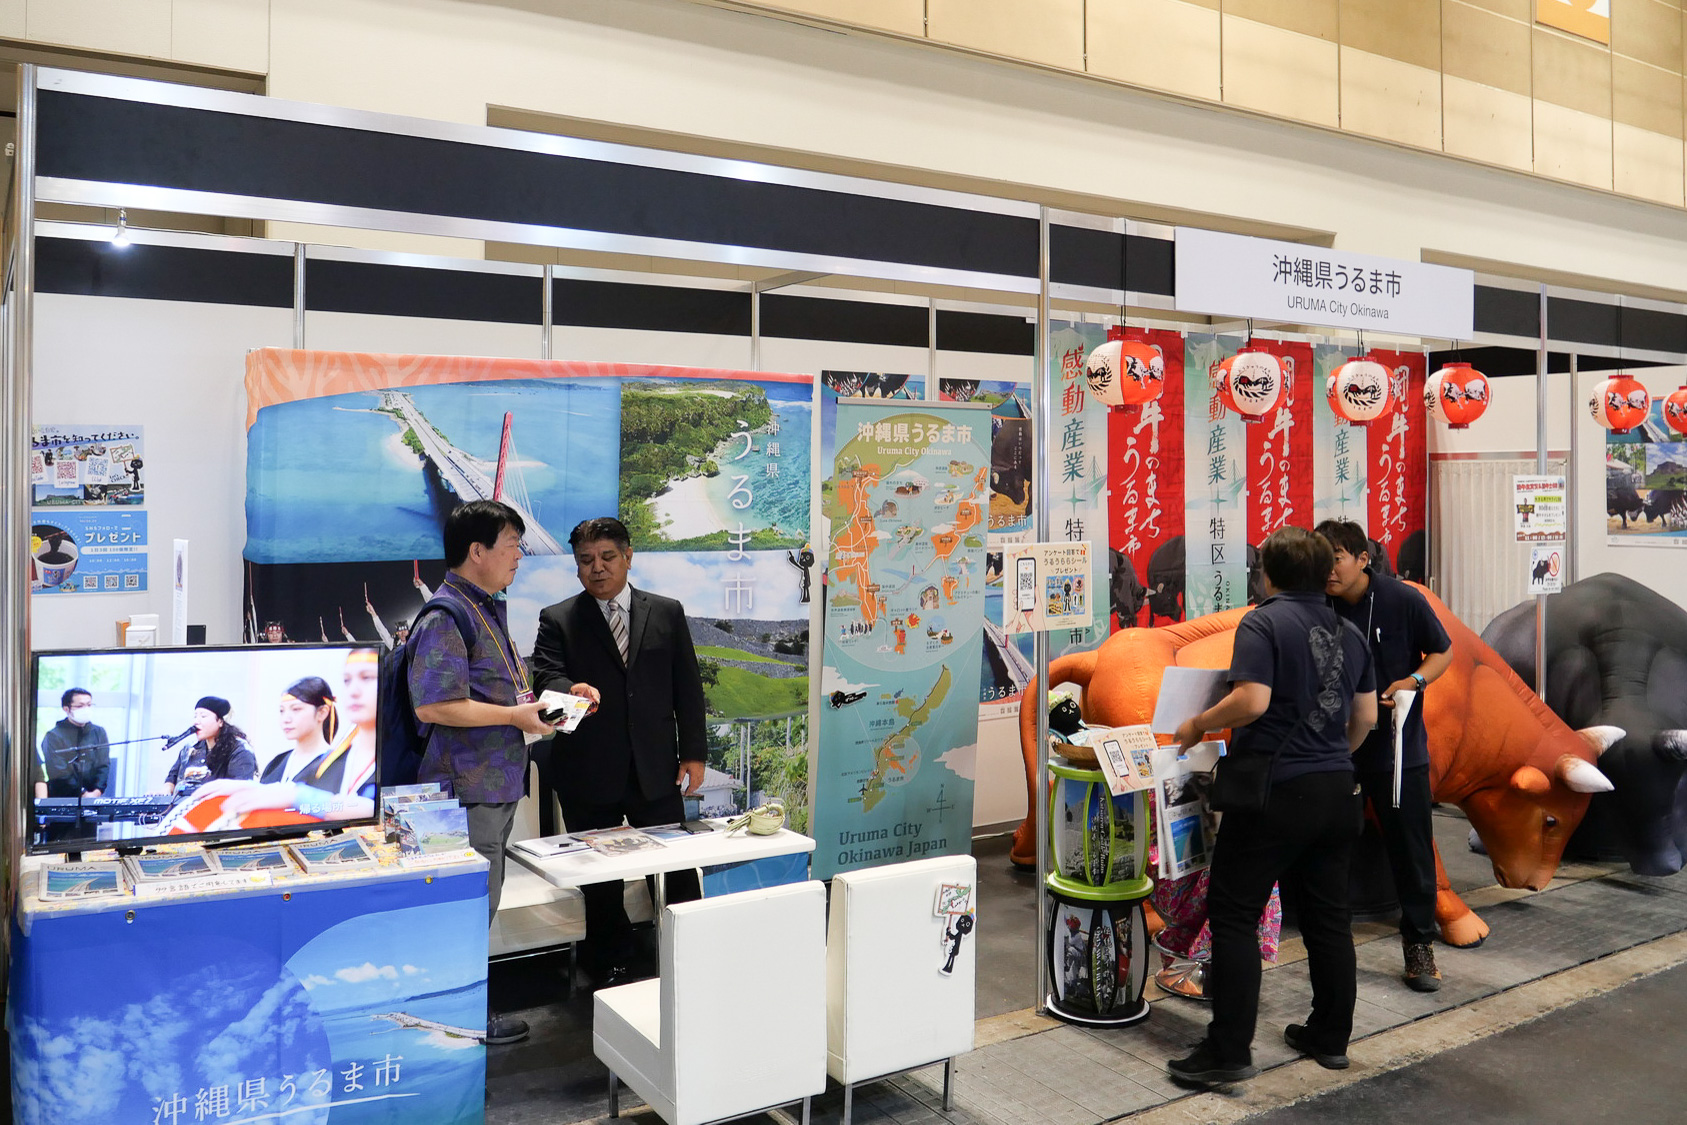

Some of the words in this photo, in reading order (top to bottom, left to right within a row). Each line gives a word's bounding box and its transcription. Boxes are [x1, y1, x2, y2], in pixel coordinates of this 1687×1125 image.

[1272, 254, 1402, 298] 沖縄県うるま市
[1287, 295, 1327, 312] URUMA
[1329, 301, 1348, 318] City
[1350, 302, 1389, 319] Okinawa
[1061, 343, 1085, 484] 感動産業
[766, 421, 780, 478] 沖縄県
[857, 421, 972, 445] 沖縄県うるま市
[1133, 344, 1165, 538] 牛のまち
[877, 446, 903, 456] Uruma
[904, 447, 920, 457] City
[921, 447, 951, 456] Okinawa
[1120, 437, 1142, 554] うるま市
[1376, 443, 1392, 544] うるま市
[720, 419, 757, 614] うるま市
[988, 515, 1028, 528] うるま市
[84, 531, 142, 544] プレゼント
[299, 803, 343, 815] 帰る場所
[838, 846, 904, 866] Okinawa
[906, 837, 948, 857] Japan
[839, 827, 889, 846] Uruma
[893, 822, 923, 839] City
[152, 1053, 404, 1125] 沖縄県うるま市
